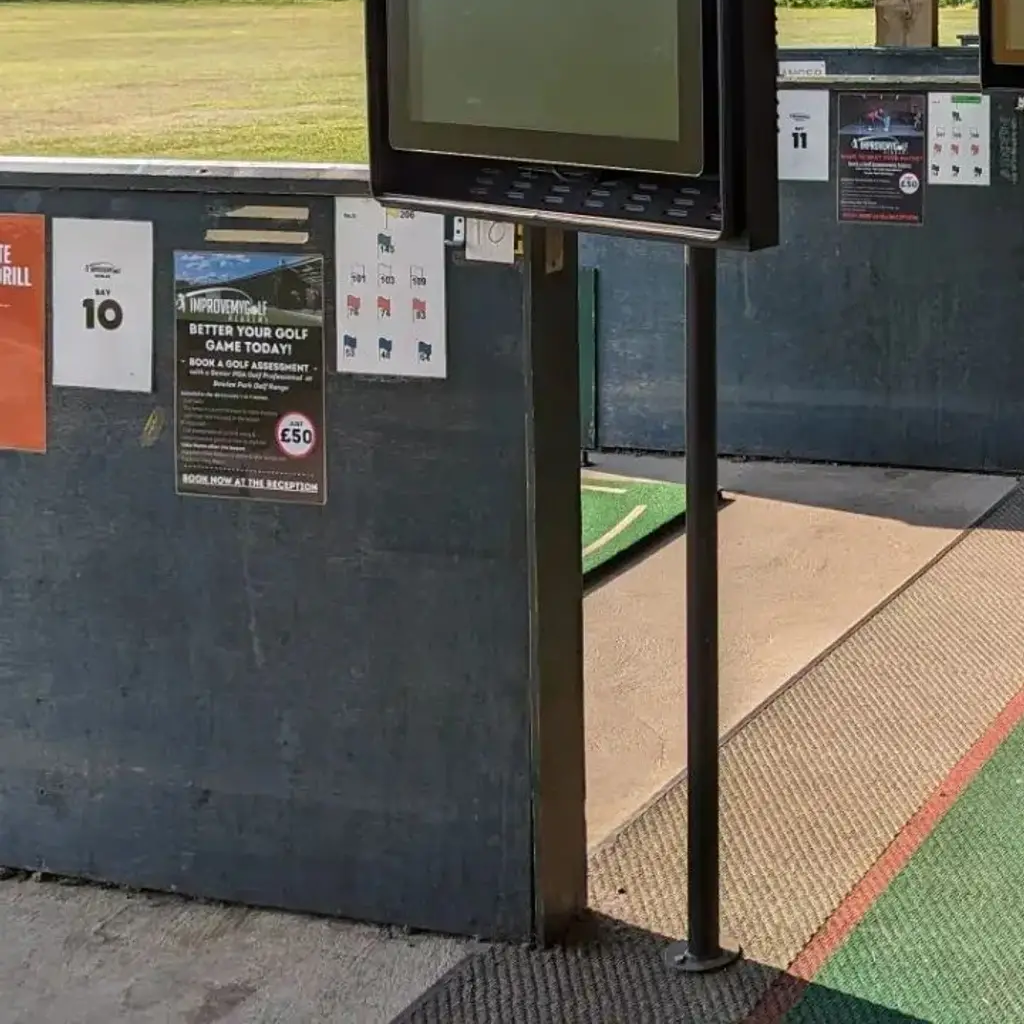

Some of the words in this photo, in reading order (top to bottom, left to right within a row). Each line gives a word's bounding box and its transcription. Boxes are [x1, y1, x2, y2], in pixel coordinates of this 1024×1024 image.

[792, 133, 807, 149] 11
[399, 211, 415, 219] 206
[82, 298, 123, 330] 10
[189, 323, 233, 337] BETTER
[237, 325, 272, 338] YOUR
[275, 328, 308, 341] GOLF
[205, 340, 242, 353] GAME
[245, 342, 292, 355] TODAY!
[189, 358, 215, 367] BOOK
[225, 360, 249, 369] GOLF
[251, 362, 309, 372] ASSESSMENT
[280, 428, 312, 444] £50
[182, 474, 208, 484] BOOK
[210, 475, 232, 485] NOW
[234, 477, 246, 486] AT
[248, 478, 264, 488] THE
[267, 479, 318, 491] RECEPTION
